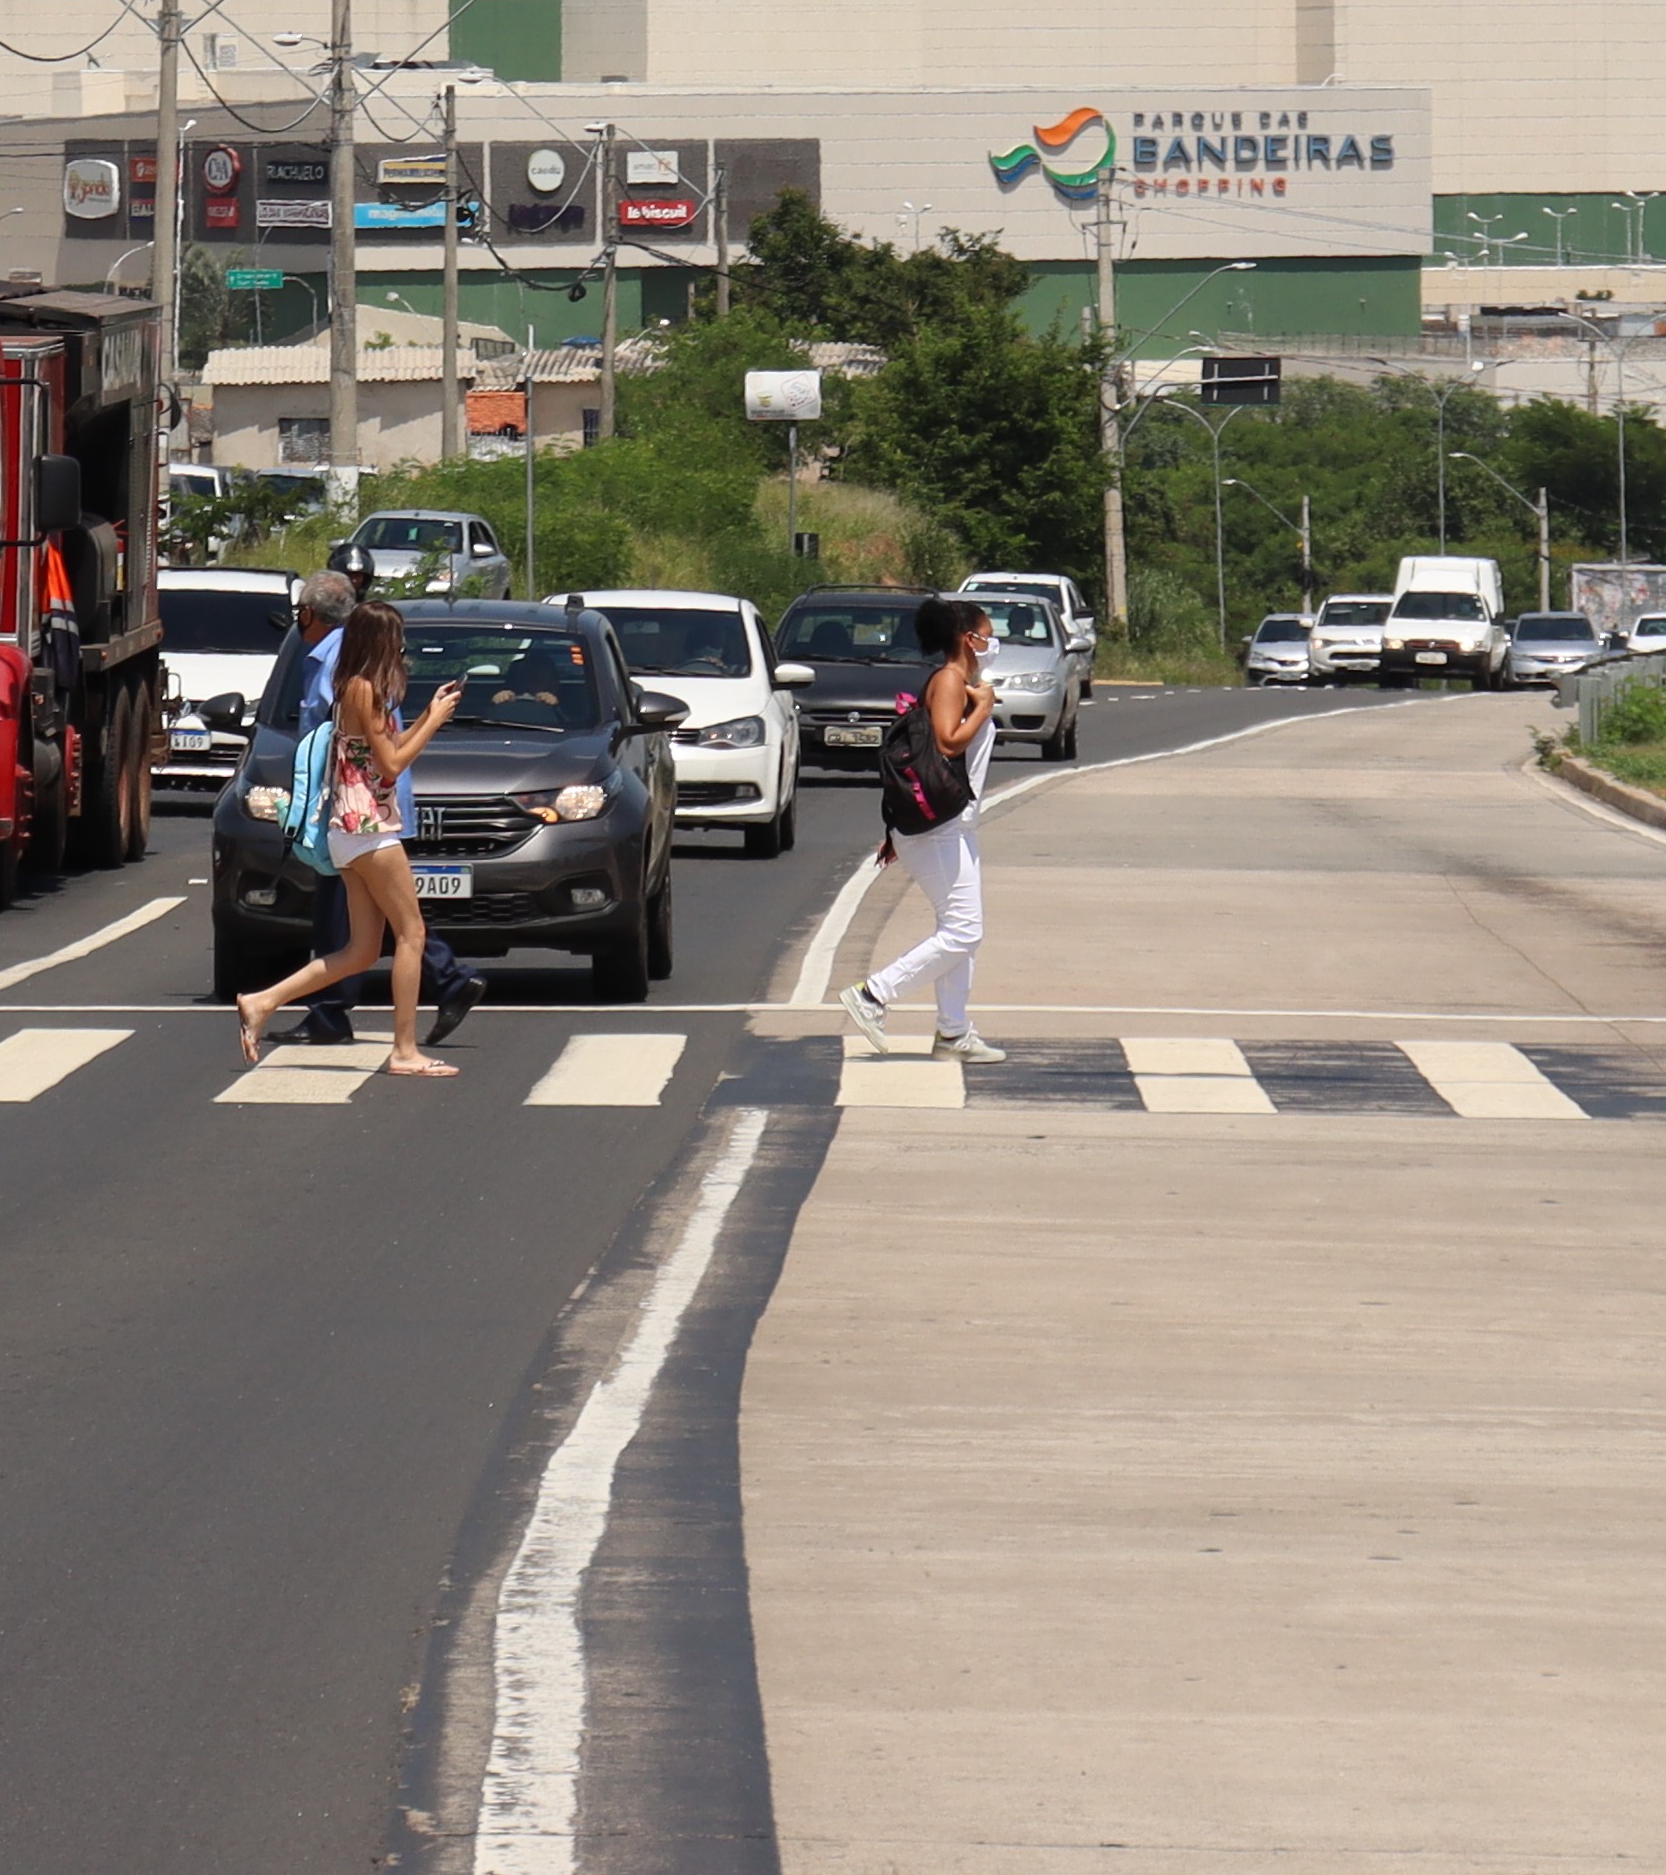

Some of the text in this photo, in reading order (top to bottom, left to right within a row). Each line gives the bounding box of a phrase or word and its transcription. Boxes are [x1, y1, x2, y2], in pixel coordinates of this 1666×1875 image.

[1133, 111, 1309, 131] PARQUE DAS
[1134, 134, 1395, 171] BANDEIRAS
[1134, 178, 1288, 196] SHOPPING
